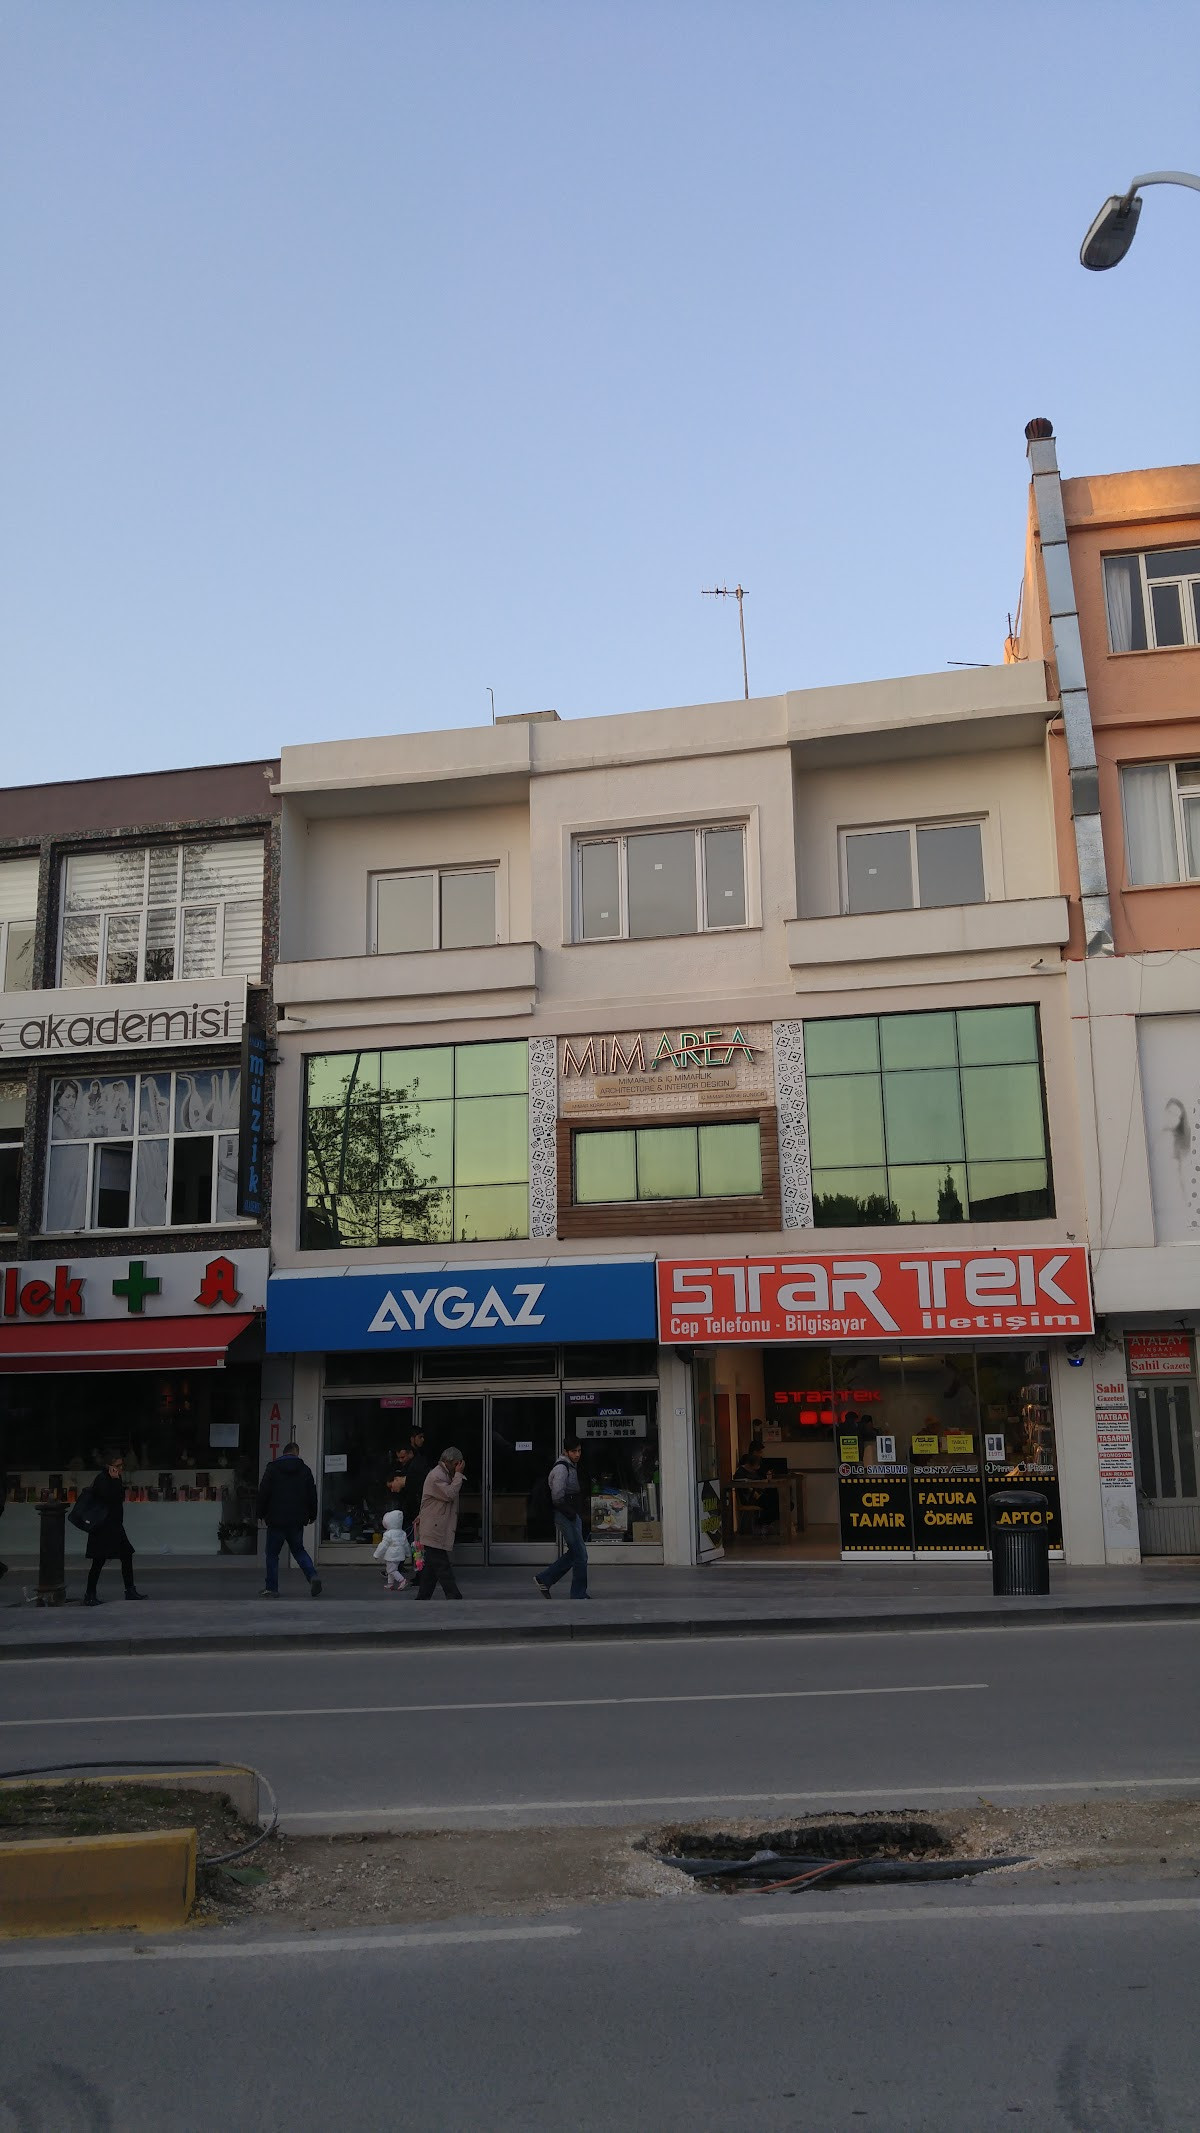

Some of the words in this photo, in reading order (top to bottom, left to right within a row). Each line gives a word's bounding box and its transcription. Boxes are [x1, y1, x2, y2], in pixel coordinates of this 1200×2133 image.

[19, 1000, 231, 1050] akademisi
[599, 1085, 655, 1095] ARCHITECTURE
[664, 1082, 699, 1091] INTERIOR
[700, 1080, 731, 1089] DESIGN
[248, 1054, 265, 1194] müzik
[367, 1283, 546, 1332] AYGAZ
[670, 1318, 699, 1338] Cep
[705, 1315, 771, 1334] Telefonu
[785, 1313, 867, 1335] Bilgisayar
[1131, 1335, 1184, 1346] ATALAY
[1131, 1360, 1160, 1371] Sahil
[1096, 1383, 1125, 1393] Sahil
[599, 1408, 623, 1416] AYGAZ
[1097, 1413, 1128, 1421] MATBAA
[587, 1418, 608, 1429] GÜNEŞ
[609, 1417, 635, 1428] TİCARET
[852, 1465, 864, 1475] LG
[867, 1464, 908, 1475] SAMSUNG
[913, 1464, 949, 1475] SONY
[949, 1463, 979, 1474] ASUS
[861, 1491, 891, 1507] CEP
[918, 1491, 977, 1505] FATURA
[923, 1509, 974, 1526] ÖDEME
[995, 1510, 1055, 1525] APTOP
